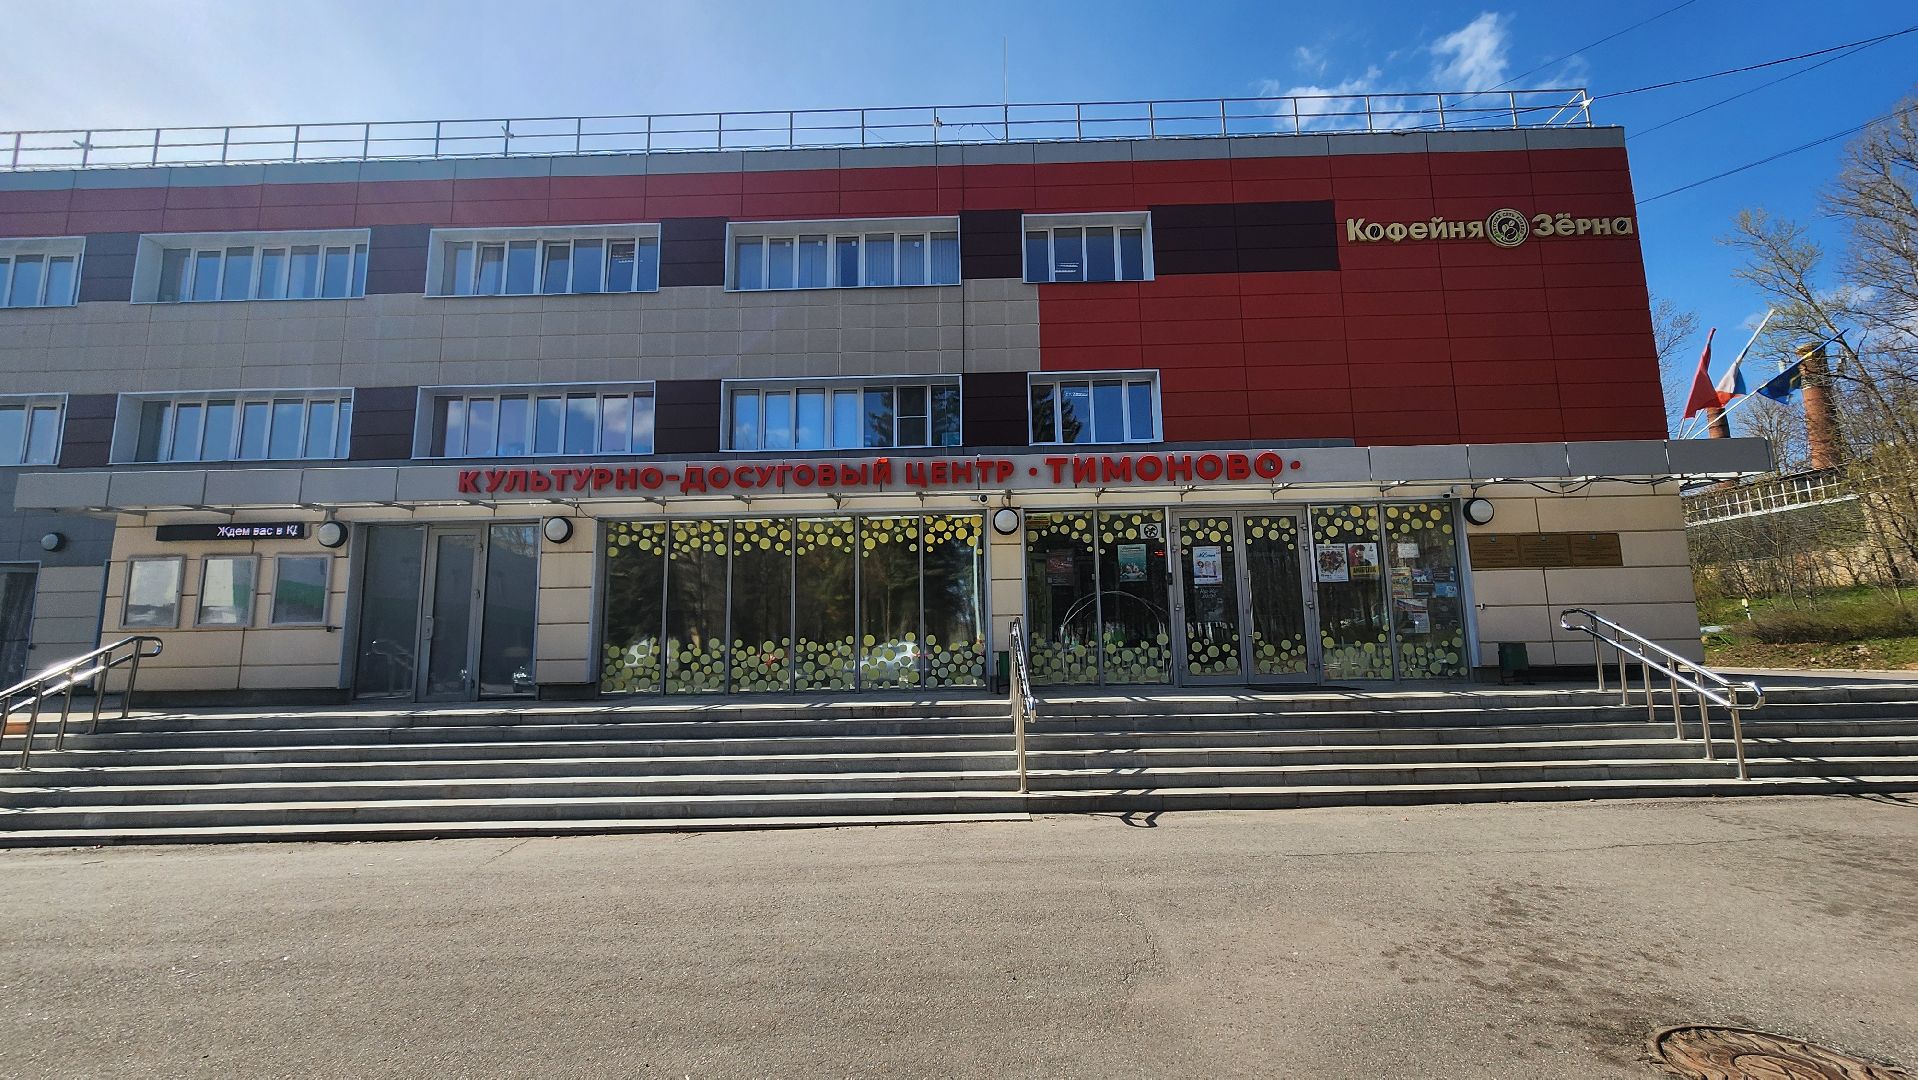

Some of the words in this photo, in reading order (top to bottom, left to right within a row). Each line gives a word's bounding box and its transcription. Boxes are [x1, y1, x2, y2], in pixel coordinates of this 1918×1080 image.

[1346, 216, 1484, 242] Кофейня
[1531, 213, 1634, 237] Зёрна
[458, 458, 893, 493] КУЛЬТУРНО-ДОСУГОВЫЙ
[905, 460, 1015, 488] ЦЕНТР
[1044, 451, 1283, 484] ТИМОНОВО
[217, 526, 250, 538] Ждем
[253, 527, 273, 536] вас
[276, 527, 283, 535] в
